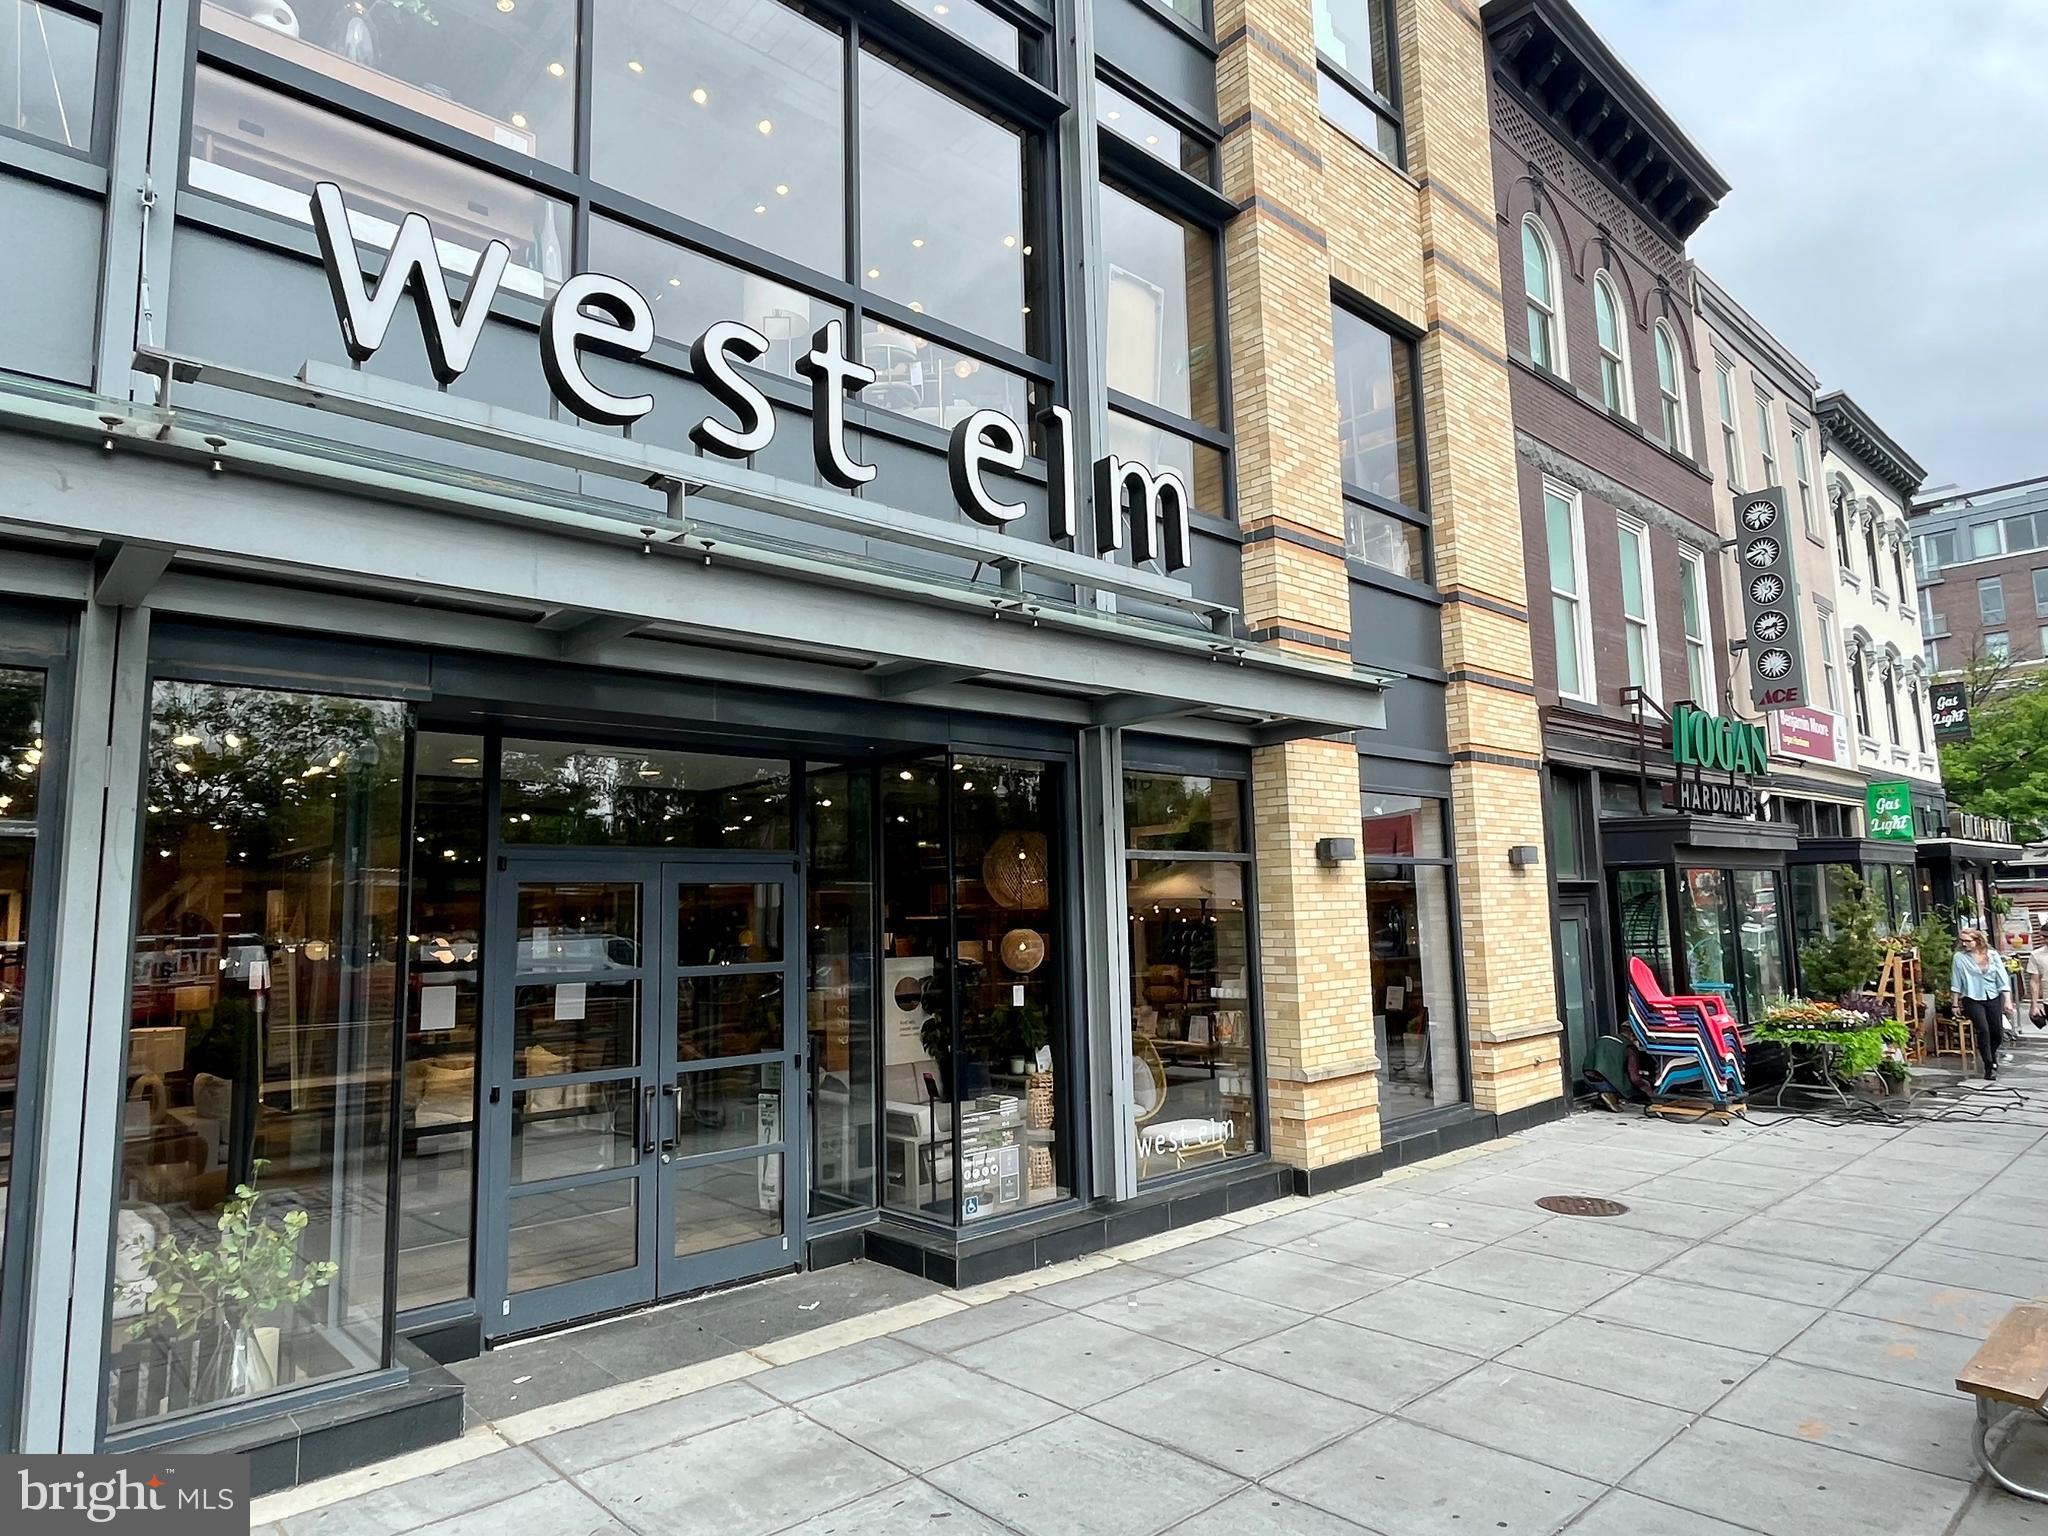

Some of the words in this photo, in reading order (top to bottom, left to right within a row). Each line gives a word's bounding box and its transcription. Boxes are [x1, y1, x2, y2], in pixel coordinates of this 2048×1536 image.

[310, 181, 878, 489] west
[948, 404, 1192, 571] elm
[1759, 687, 1798, 705] ACE
[1936, 695, 1959, 710] Gas
[1932, 709, 1968, 728] Light
[1673, 704, 1767, 776] LOGAN
[1681, 782, 1758, 816] HARDWARE
[1875, 797, 1901, 815] Gas
[1871, 814, 1912, 835] Light
[1137, 1124, 1190, 1158] west
[1199, 1117, 1235, 1145] elm
